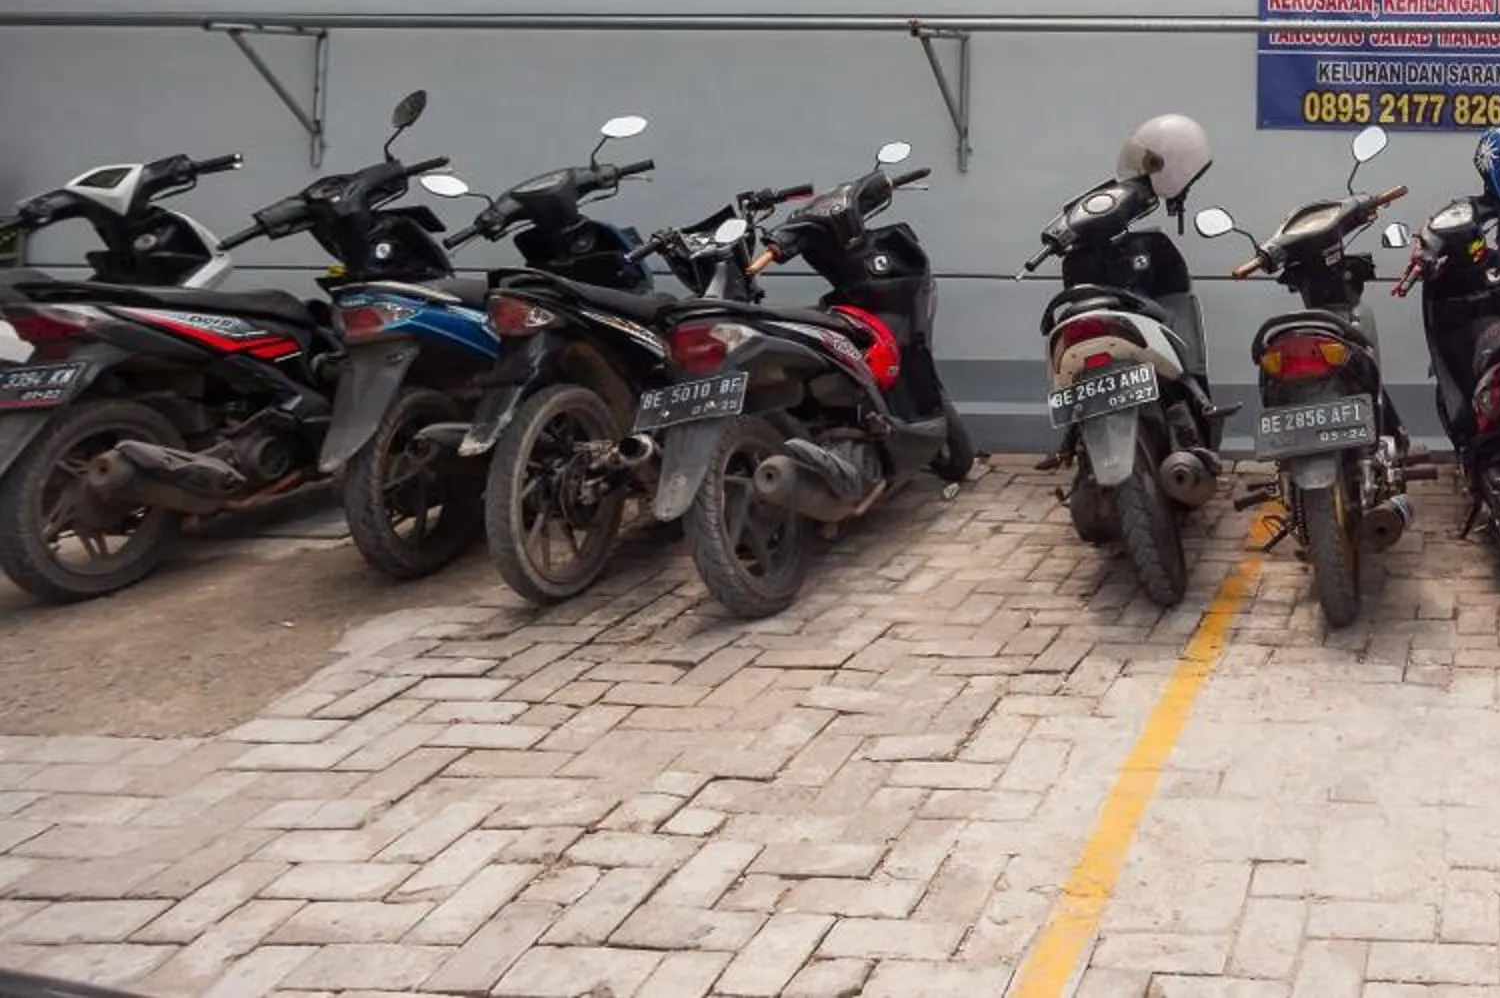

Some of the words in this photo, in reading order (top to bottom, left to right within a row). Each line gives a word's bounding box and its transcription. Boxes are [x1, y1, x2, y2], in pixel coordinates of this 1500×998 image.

[1317, 60, 1401, 84] KELUHAN
[1406, 63, 1445, 85] DAN
[1303, 92, 1371, 124] 0895
[1379, 93, 1446, 125] 2177
[641, 391, 664, 410] BE
[671, 382, 712, 404] 5010
[1051, 390, 1073, 408] BE
[1076, 377, 1116, 401] 2643
[1261, 415, 1281, 434] BE
[1285, 409, 1327, 431] 2856
